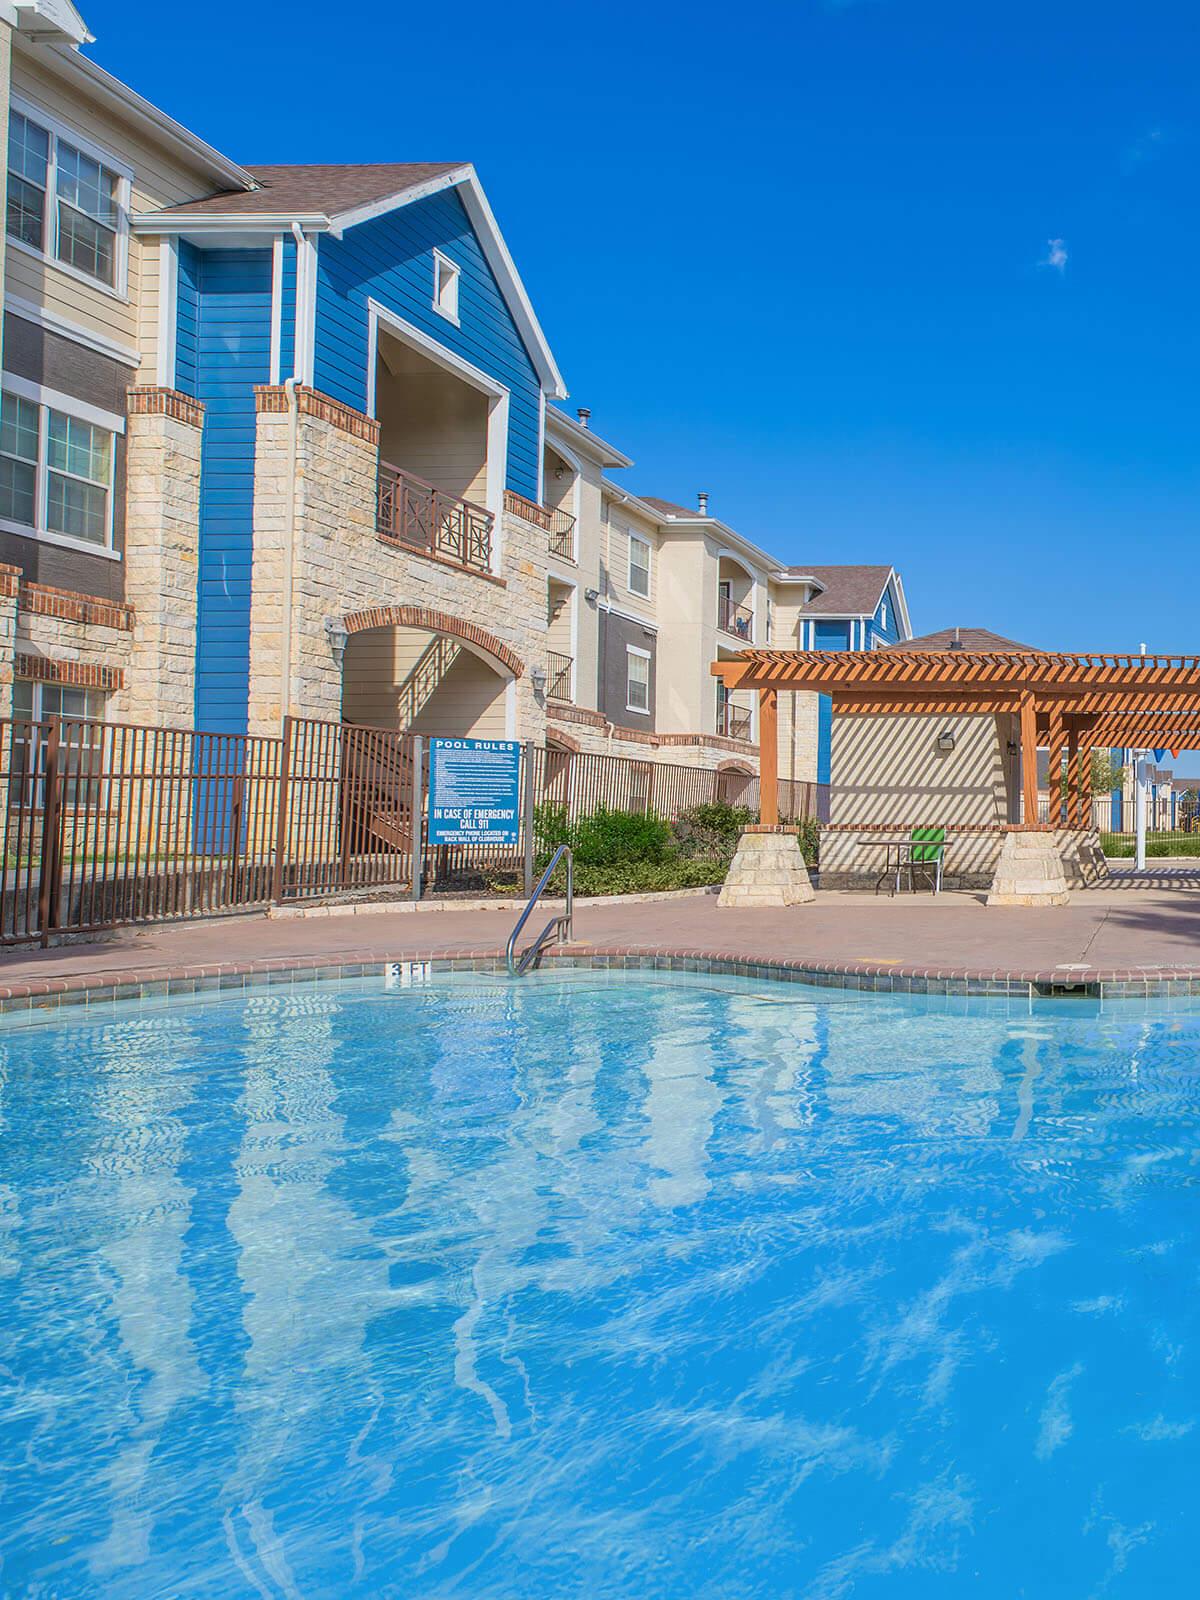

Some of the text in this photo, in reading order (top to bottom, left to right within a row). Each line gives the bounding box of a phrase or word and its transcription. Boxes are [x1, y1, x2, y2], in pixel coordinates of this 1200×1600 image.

[436, 740, 514, 750] POOL RULES
[434, 808, 514, 819] IN CASE OF EMERGENCY
[460, 819, 488, 829] CALL 911
[392, 961, 429, 976] 3 FT
